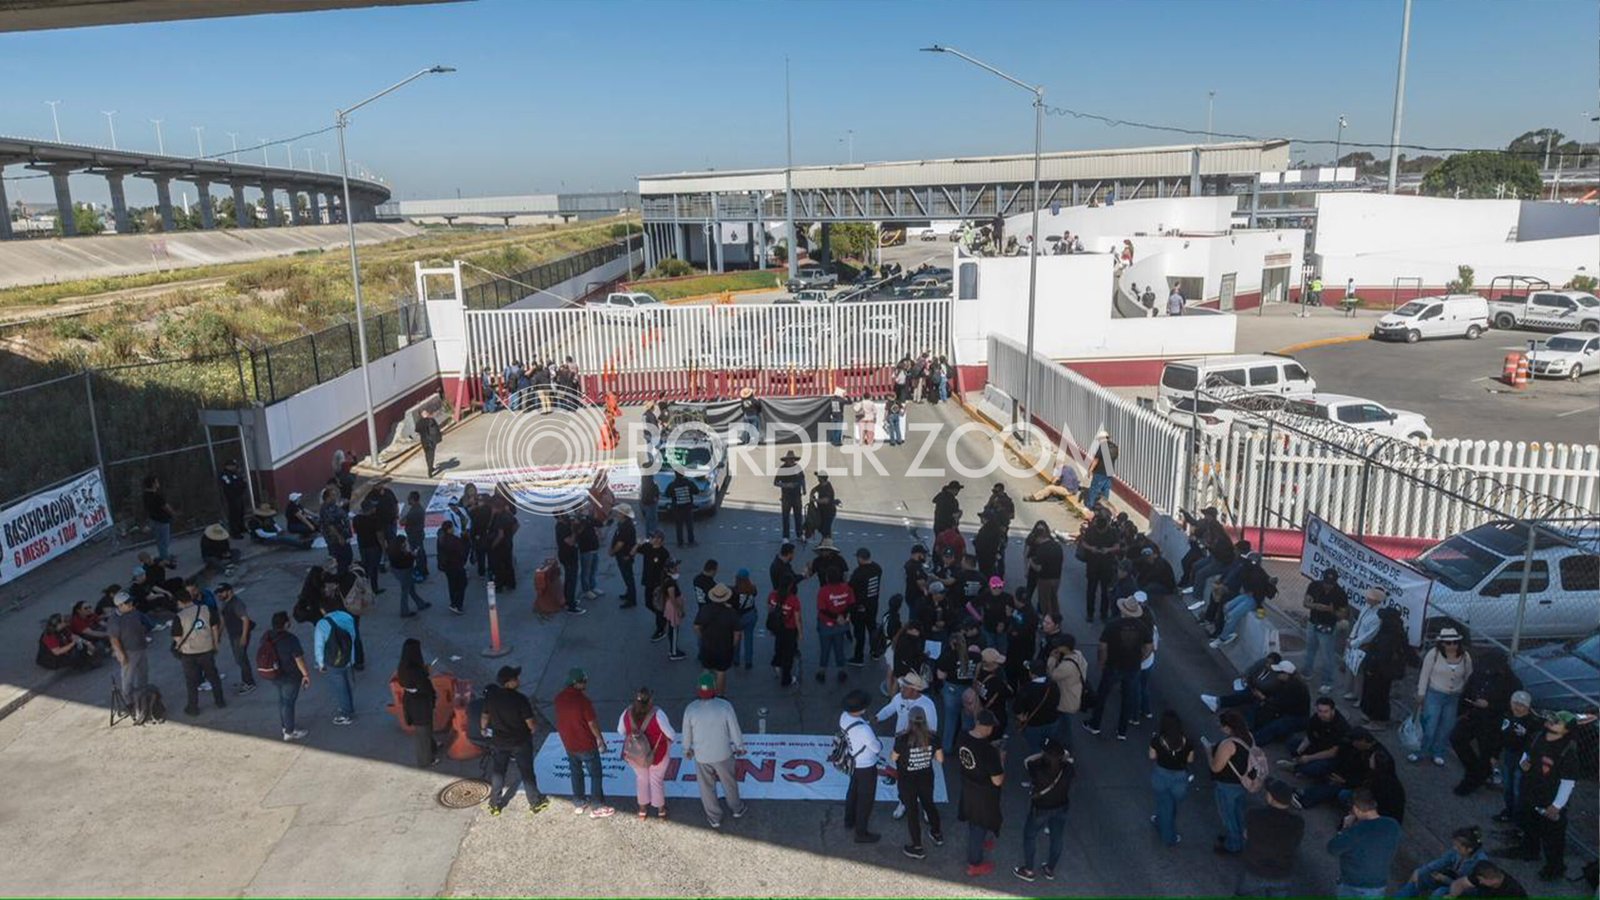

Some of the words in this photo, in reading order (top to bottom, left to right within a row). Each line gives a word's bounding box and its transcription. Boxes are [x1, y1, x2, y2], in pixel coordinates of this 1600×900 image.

[3, 493, 77, 549] BASIFICACIÓN
[14, 550, 21, 568] 6
[22, 537, 50, 565] MESES
[1368, 556, 1389, 574] PAGO
[1389, 568, 1401, 581] DE
